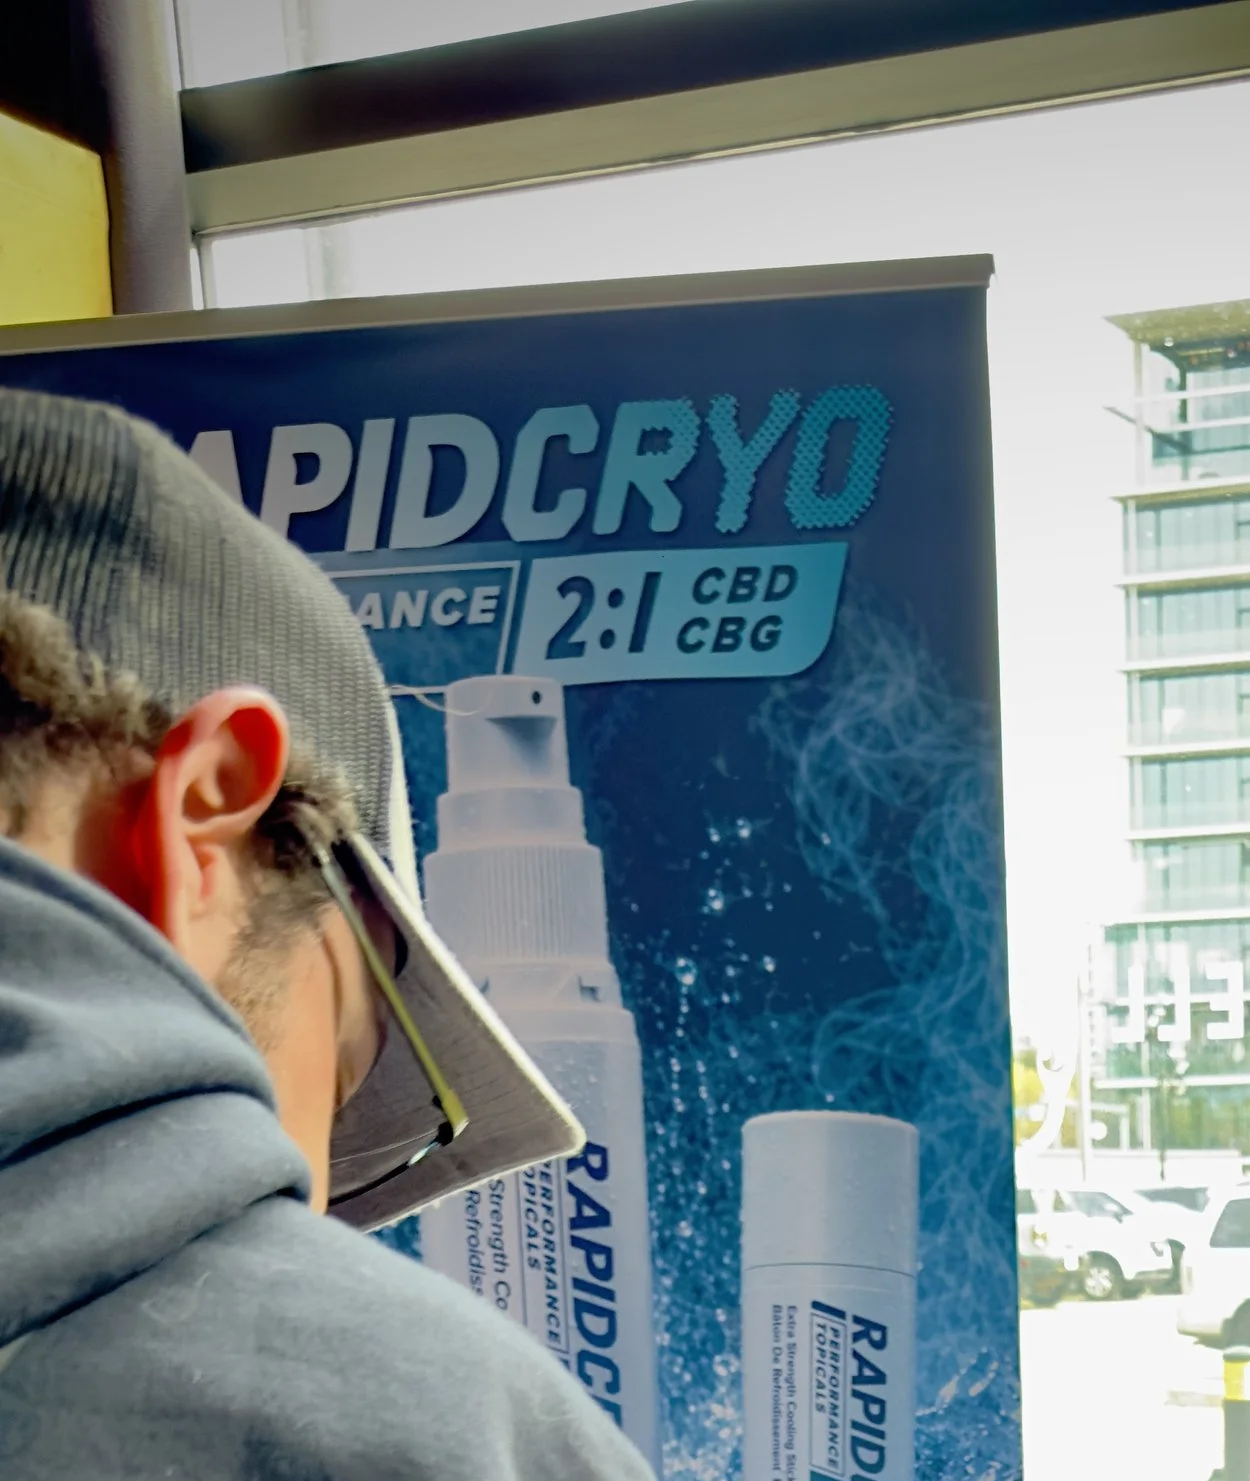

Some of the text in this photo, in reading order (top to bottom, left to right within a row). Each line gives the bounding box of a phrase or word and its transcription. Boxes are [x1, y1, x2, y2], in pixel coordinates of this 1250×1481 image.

[545, 571, 663, 659] 2:1
[692, 565, 798, 604] CBD
[676, 615, 782, 653] CBG
[540, 1160, 562, 1346] ERFORMANCE
[784, 1343, 798, 1398] Strength
[814, 1322, 828, 1414] TOPICALS
[828, 1325, 842, 1470] PERFORMANCE
[784, 1401, 798, 1451] Cooling
